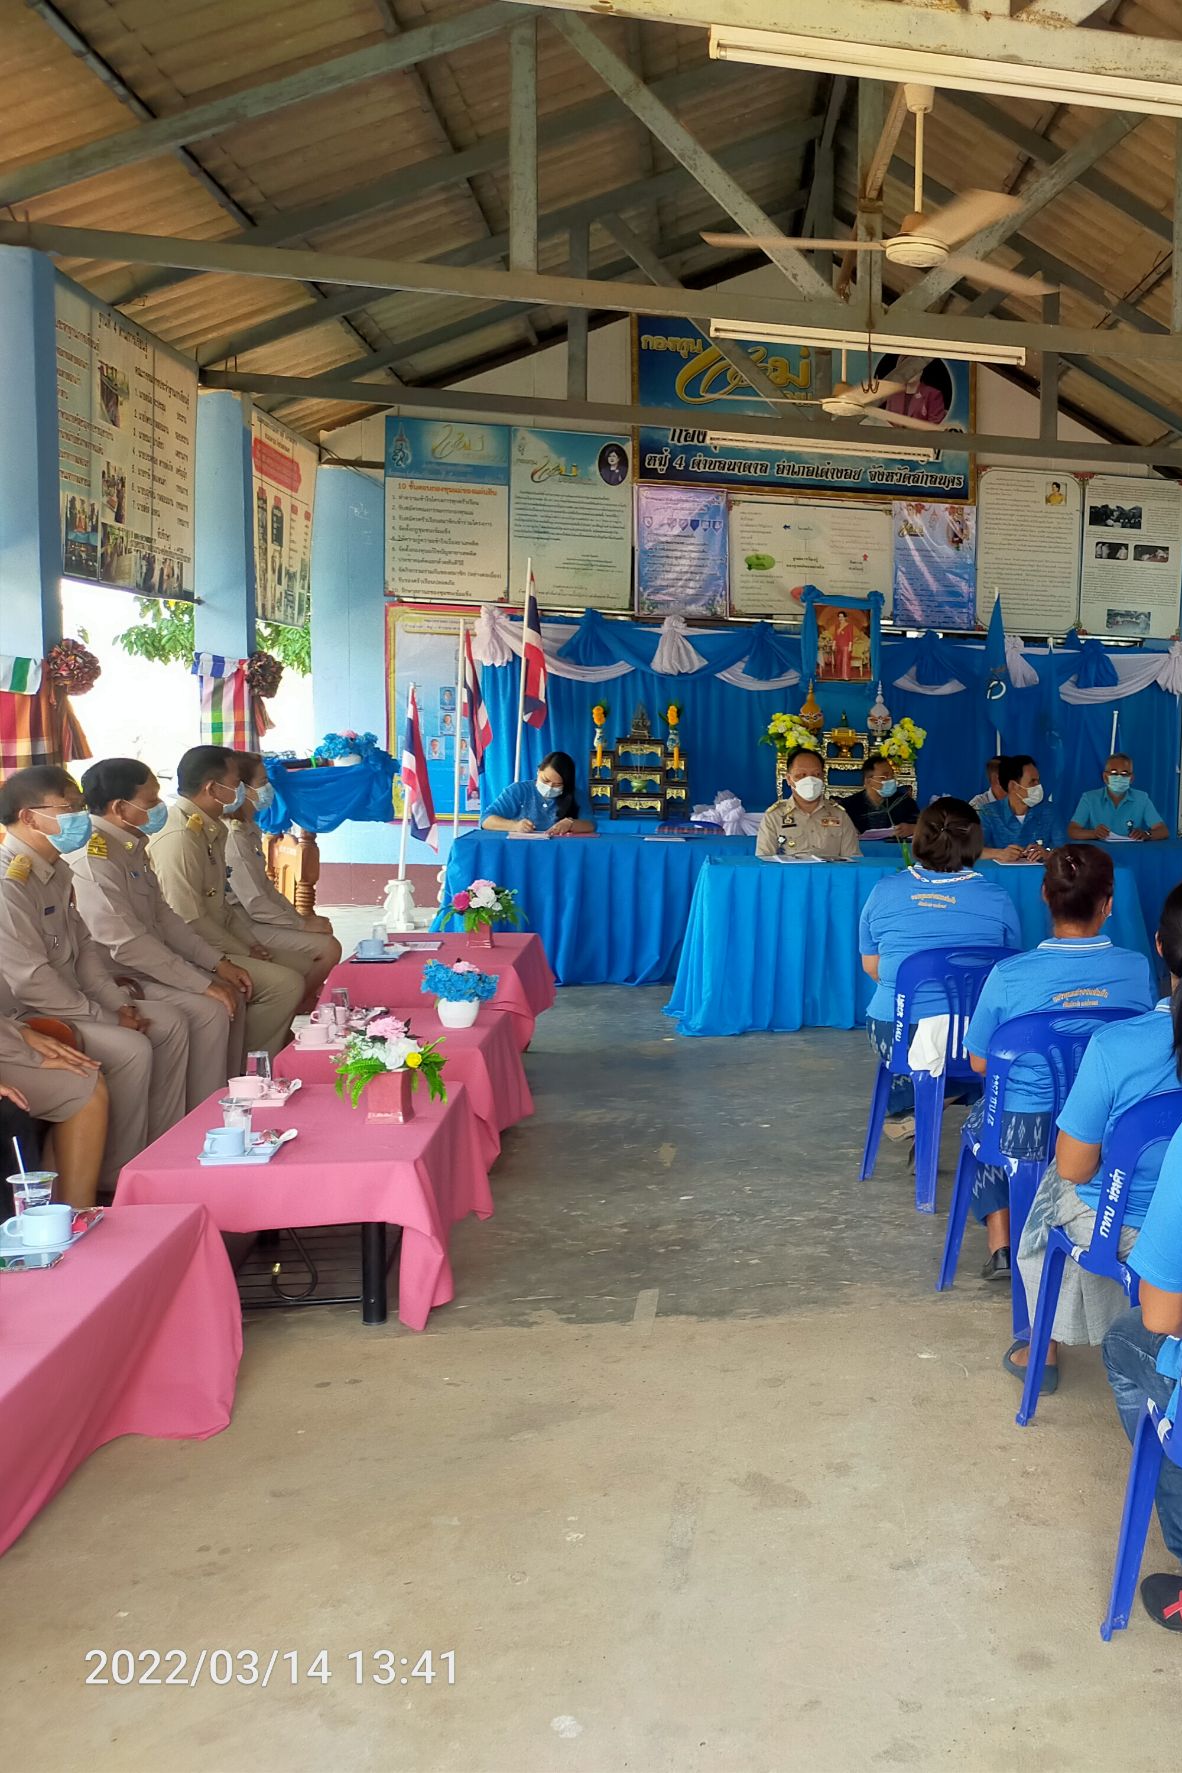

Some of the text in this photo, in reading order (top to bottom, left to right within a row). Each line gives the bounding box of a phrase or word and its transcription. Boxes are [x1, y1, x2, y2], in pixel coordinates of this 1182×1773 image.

[641, 334, 703, 358] กองทุน
[645, 448, 965, 490] หมู่ 4 ตำบลนาตาล อำเภอเต่างอย จังหวัดสกลนคร
[1099, 1205, 1117, 1239] กทบ
